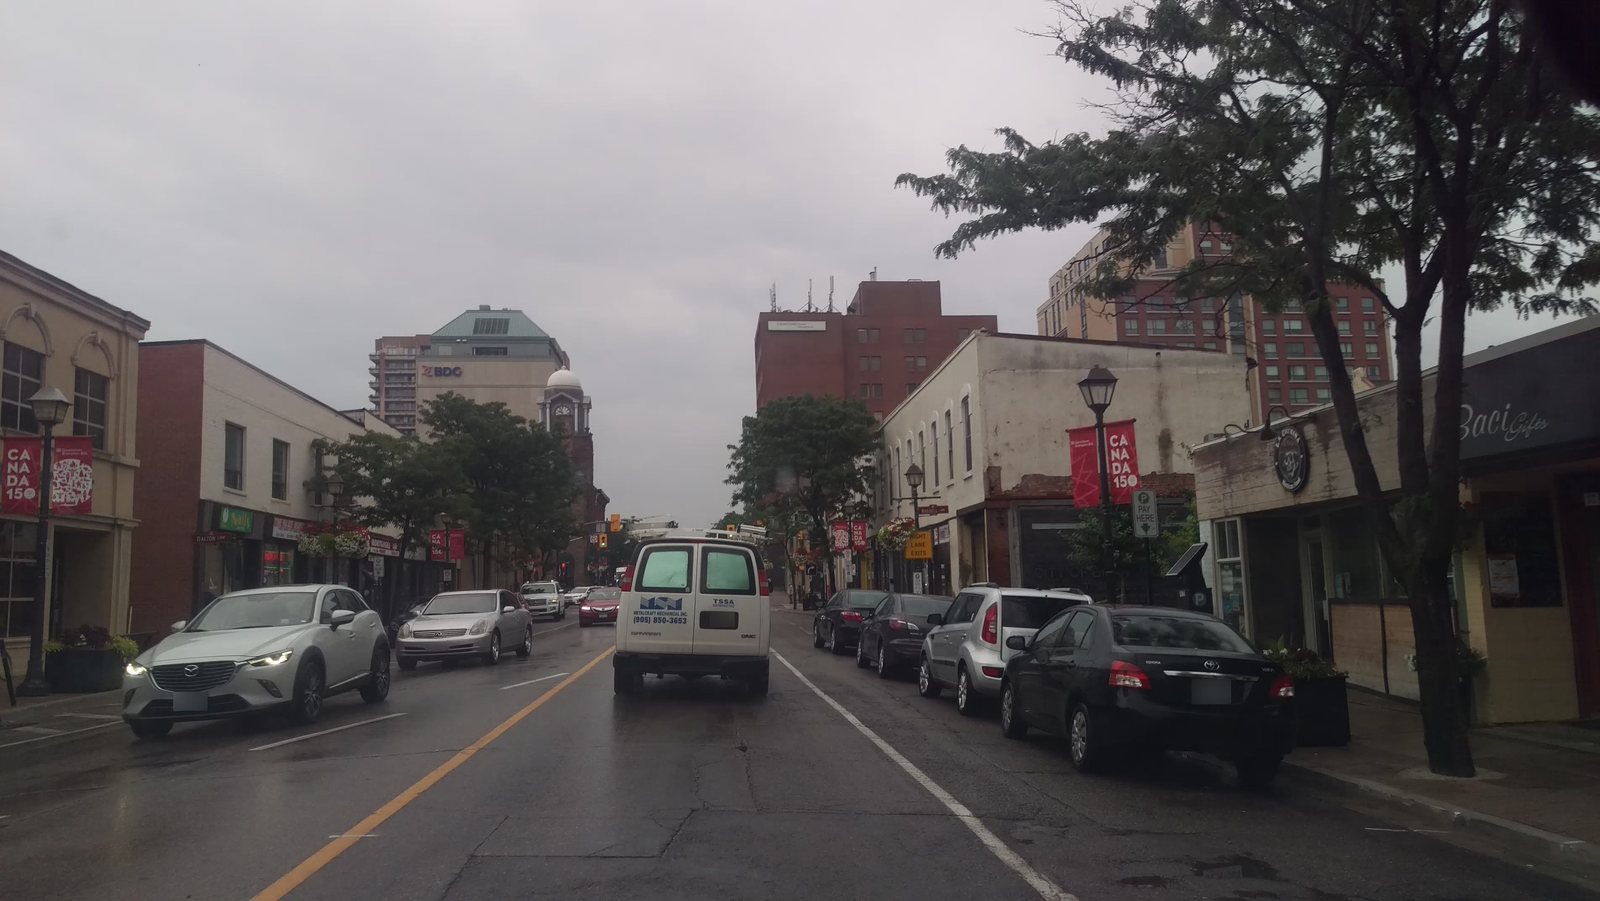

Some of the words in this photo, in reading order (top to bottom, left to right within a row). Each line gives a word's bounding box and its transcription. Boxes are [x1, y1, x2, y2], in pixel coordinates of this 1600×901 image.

[434, 366, 463, 377] BDC
[1109, 434, 1128, 447] CA
[7, 449, 31, 460] CA
[1111, 448, 1130, 461] NA
[7, 462, 31, 473] NA
[1112, 462, 1131, 475] DA
[6, 475, 30, 487] DA
[1113, 474, 1138, 488] 150
[6, 487, 36, 499] 150
[633, 616, 651, 624] (905)
